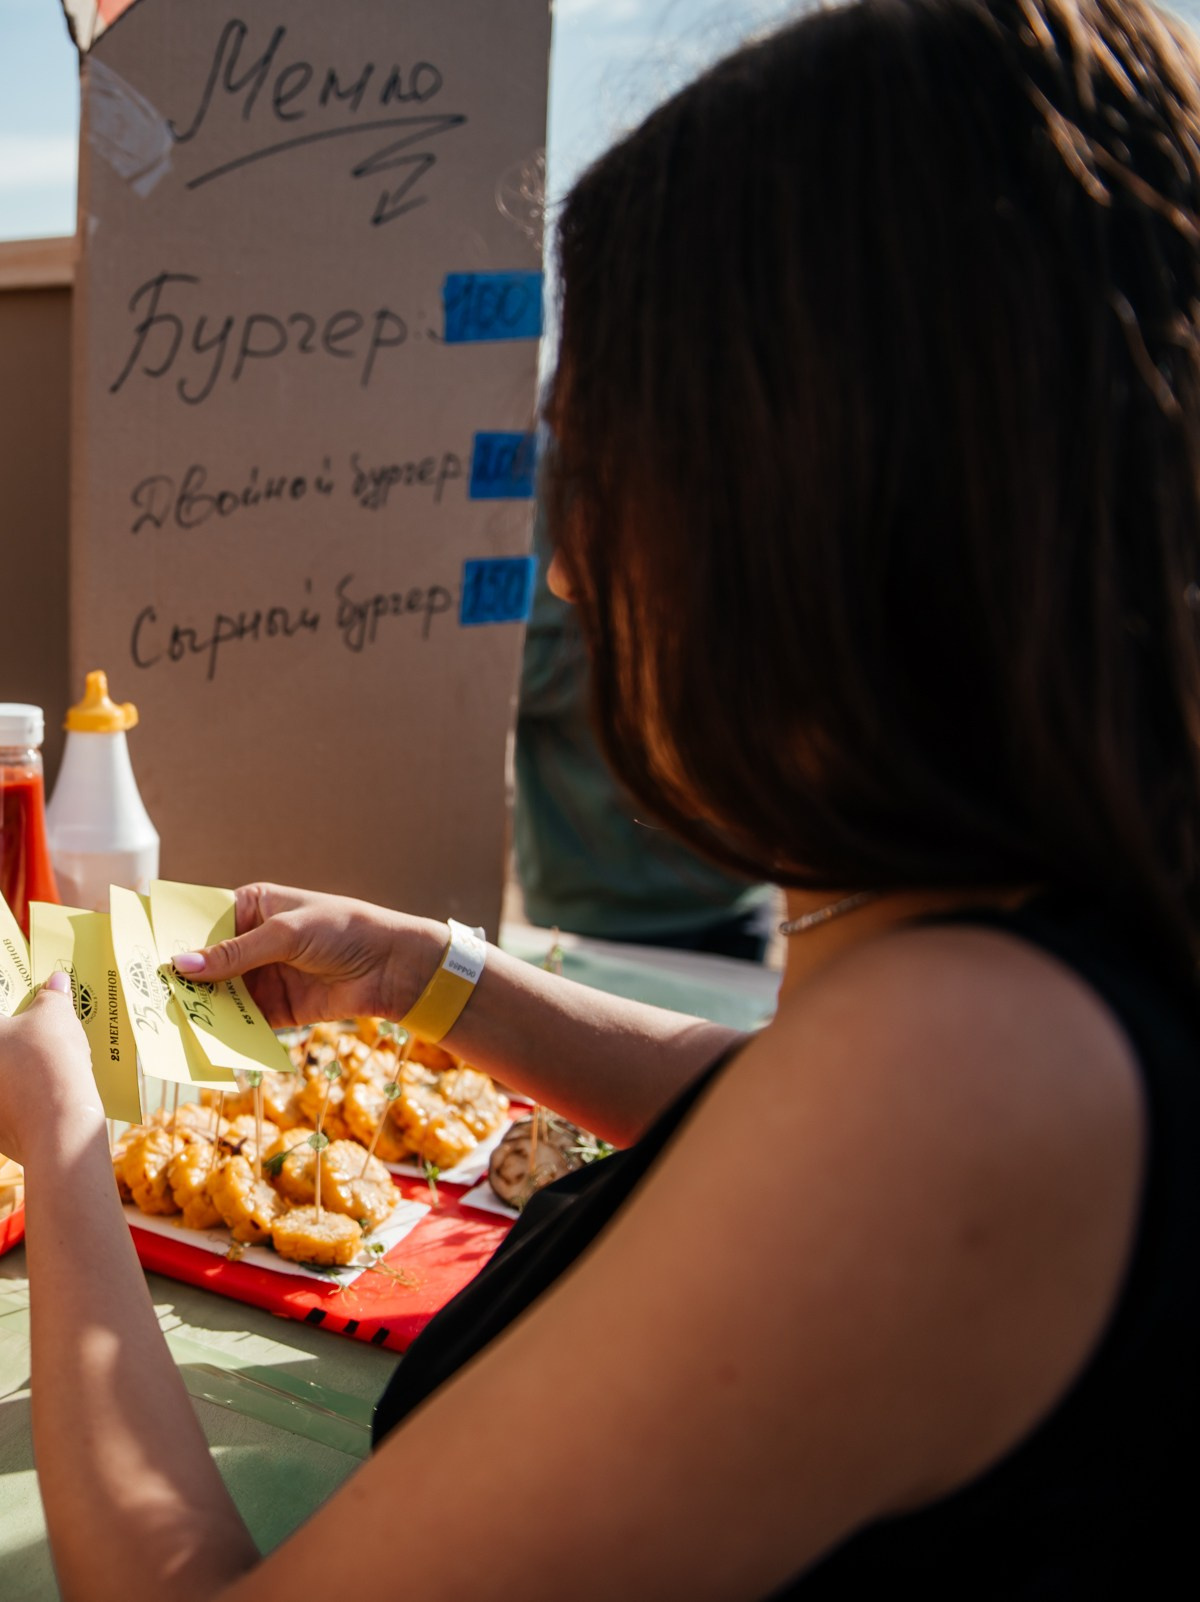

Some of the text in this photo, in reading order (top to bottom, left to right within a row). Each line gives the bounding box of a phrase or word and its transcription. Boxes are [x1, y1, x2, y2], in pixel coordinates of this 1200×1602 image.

[166, 18, 443, 142] Меню
[109, 272, 407, 405] Бургер
[131, 455, 335, 534] Двойной
[351, 452, 462, 511] бургер
[130, 578, 320, 681] Сырный
[335, 573, 452, 652] бургер
[2, 938, 34, 995] АКОИНОВ
[107, 969, 120, 1062] 25 МЕГАКОИНОВ
[133, 1003, 165, 1035] 25
[183, 1000, 215, 1027] 25
[242, 1013, 255, 1025] 25
